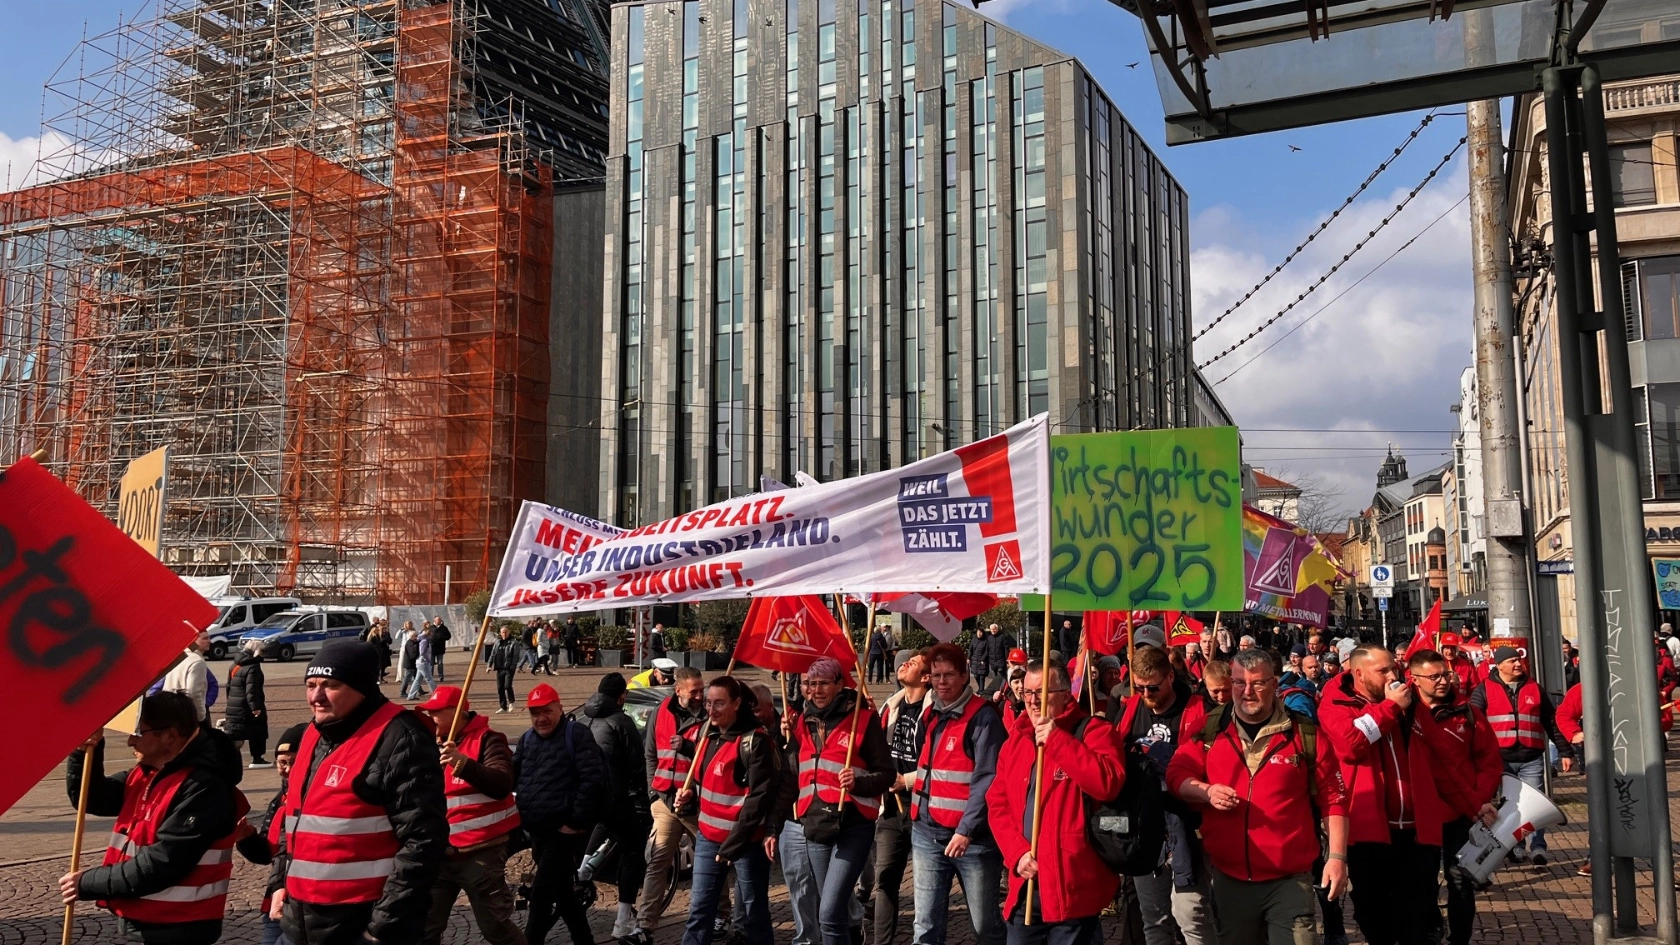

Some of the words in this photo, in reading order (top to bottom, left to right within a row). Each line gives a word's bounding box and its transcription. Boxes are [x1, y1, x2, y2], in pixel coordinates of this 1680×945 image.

[903, 479, 942, 496] WEIL
[903, 505, 938, 522] DAS
[941, 502, 988, 523] JETZT
[1055, 488, 1198, 548] wunder
[524, 550, 597, 583] UNSER
[596, 517, 841, 572] INDUSTRIELAND.
[908, 528, 962, 548] ZÄHLT.
[613, 562, 755, 597] ZUKUNFT.
[1051, 543, 1217, 608] 2025
[307, 666, 332, 676] ZINQ
